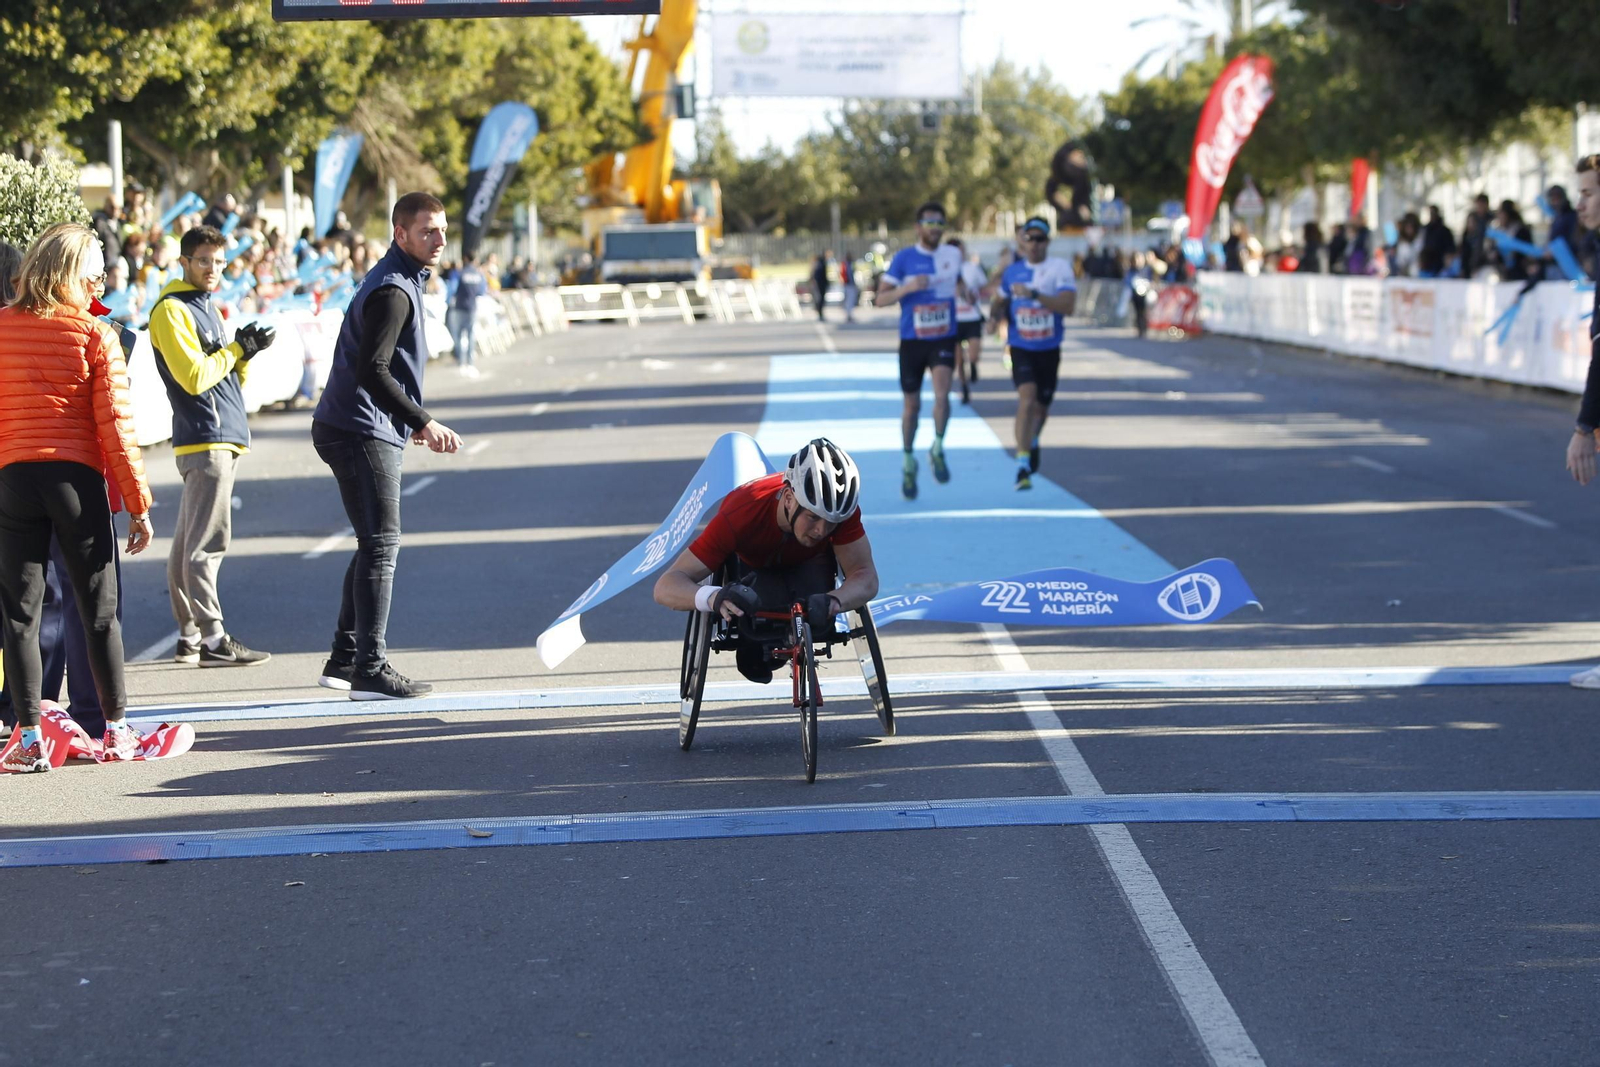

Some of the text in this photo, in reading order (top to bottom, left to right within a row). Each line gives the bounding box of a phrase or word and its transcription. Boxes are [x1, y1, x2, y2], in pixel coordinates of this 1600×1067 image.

[674, 489, 697, 528] MEDIO
[1035, 581, 1089, 591] MEDIO
[1038, 591, 1120, 603] MARATÓN
[1041, 602, 1114, 615] ALMERÍA
